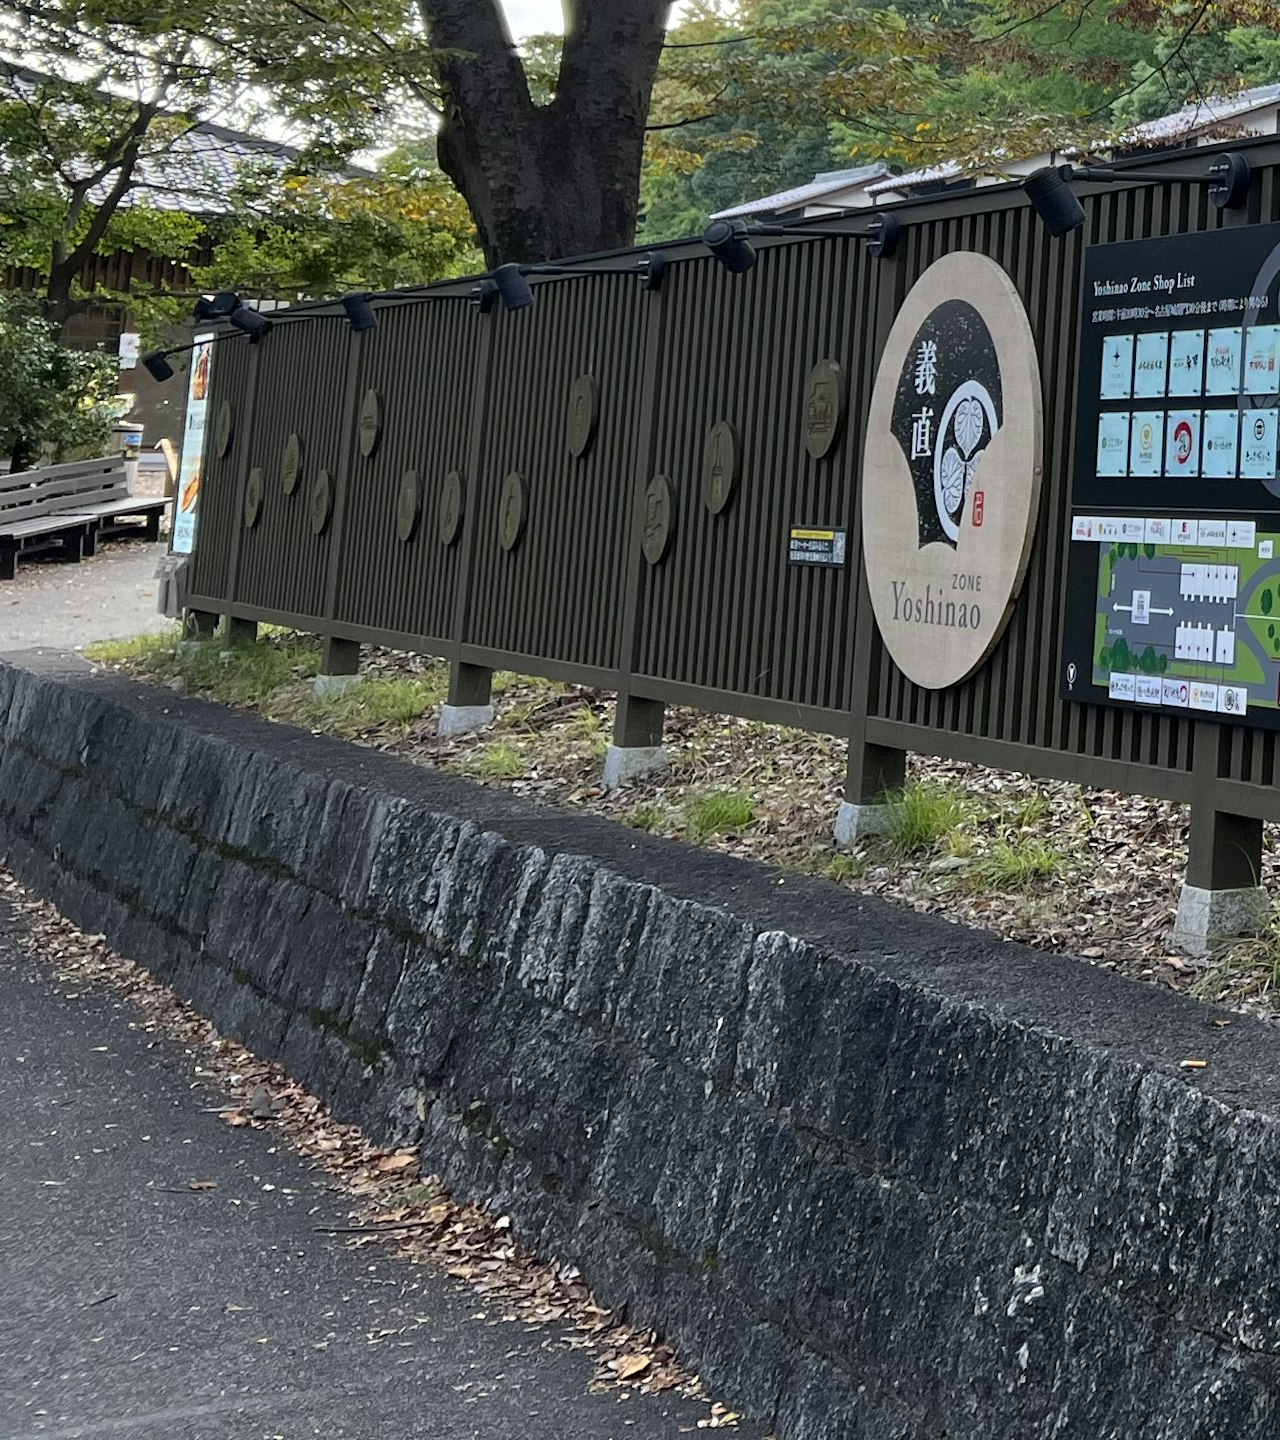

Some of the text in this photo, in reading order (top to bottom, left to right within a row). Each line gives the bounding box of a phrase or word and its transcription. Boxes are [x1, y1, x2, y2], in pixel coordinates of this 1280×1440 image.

[1094, 272, 1195, 296] Yoshinao Zone Shop List
[911, 340, 937, 460] 義直
[952, 574, 981, 592] ZONE
[892, 581, 980, 629] Yoshinao
